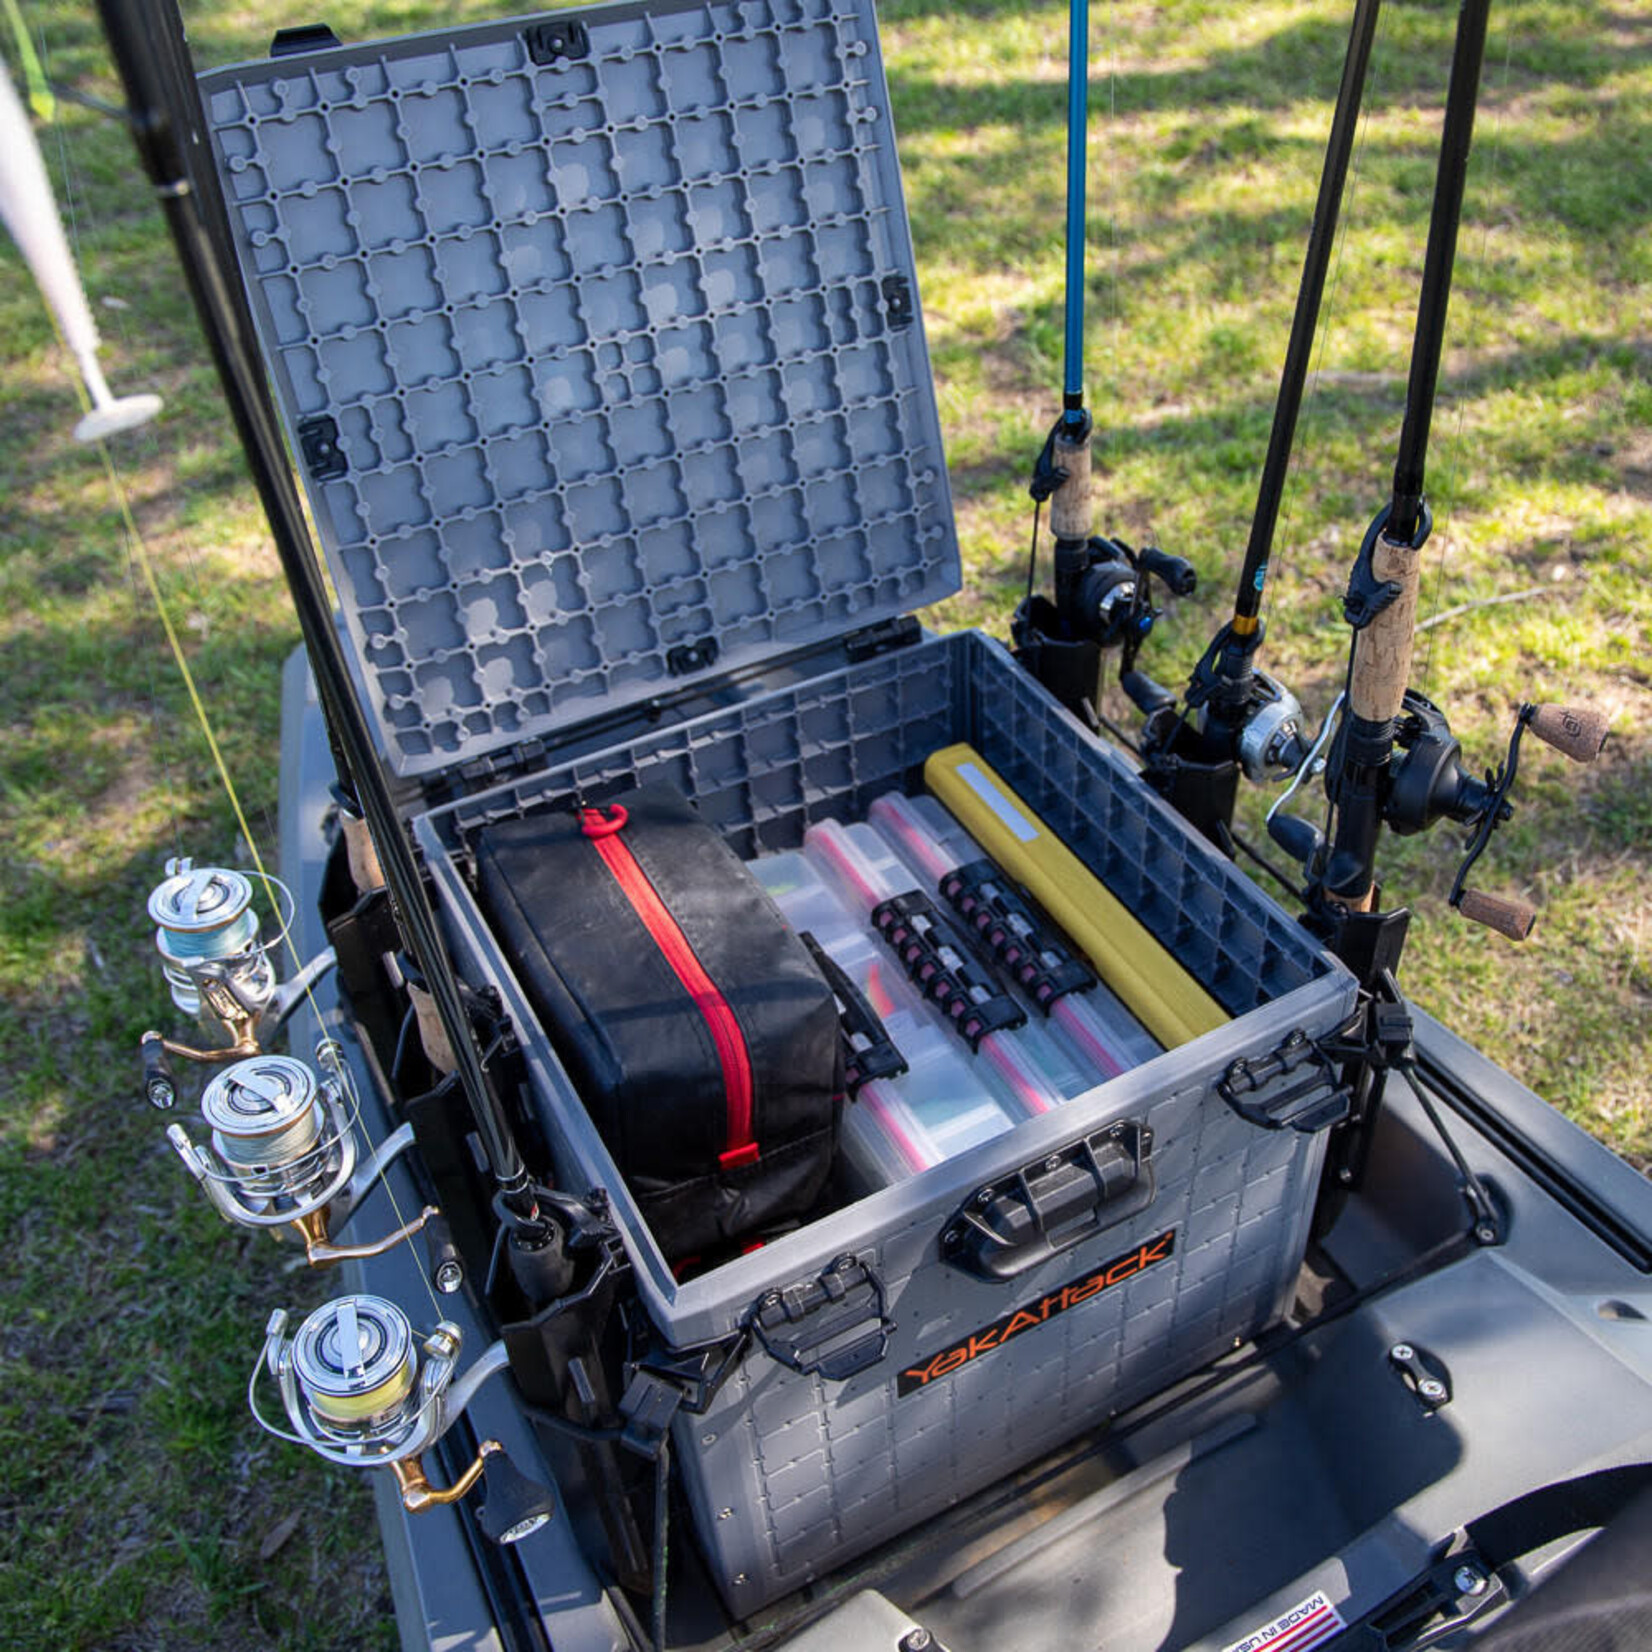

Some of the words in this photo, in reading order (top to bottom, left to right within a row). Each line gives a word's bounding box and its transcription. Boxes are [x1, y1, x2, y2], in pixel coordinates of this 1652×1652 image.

[905, 1231, 1174, 1384] YakAttack
[1277, 1596, 1324, 1630] MADE
[1261, 1626, 1278, 1640] IN
